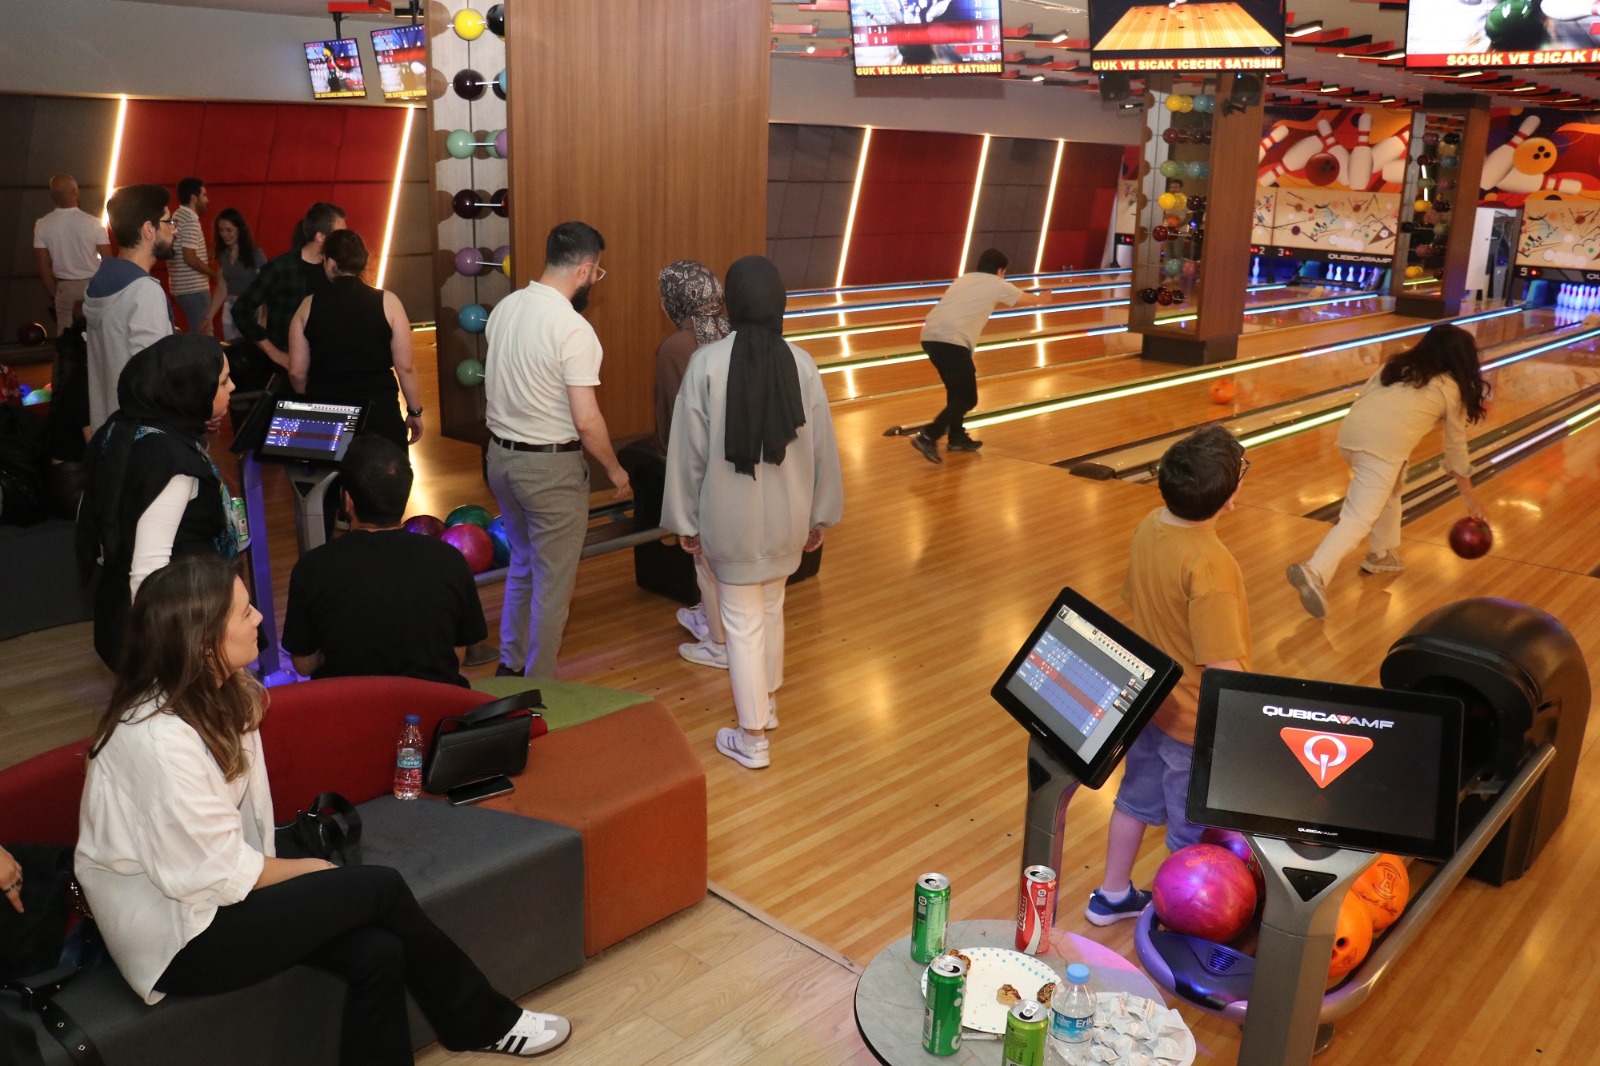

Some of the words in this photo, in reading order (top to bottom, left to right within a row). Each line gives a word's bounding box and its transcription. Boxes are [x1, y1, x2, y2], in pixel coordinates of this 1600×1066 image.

[1092, 60, 1118, 71] GUK
[1120, 60, 1136, 70] VE
[1138, 60, 1174, 70] SICAK
[1177, 58, 1222, 70] ICECEK
[1224, 57, 1282, 69] SATISIMI
[1447, 54, 1504, 66] SOGUK
[1508, 53, 1530, 65] VE
[1533, 51, 1587, 64] SICAK
[856, 66, 876, 76] GUK
[878, 66, 890, 75] VE
[891, 65, 919, 75] SICAK
[922, 64, 957, 74] ICECEK
[1278, 248, 1284, 256] 3
